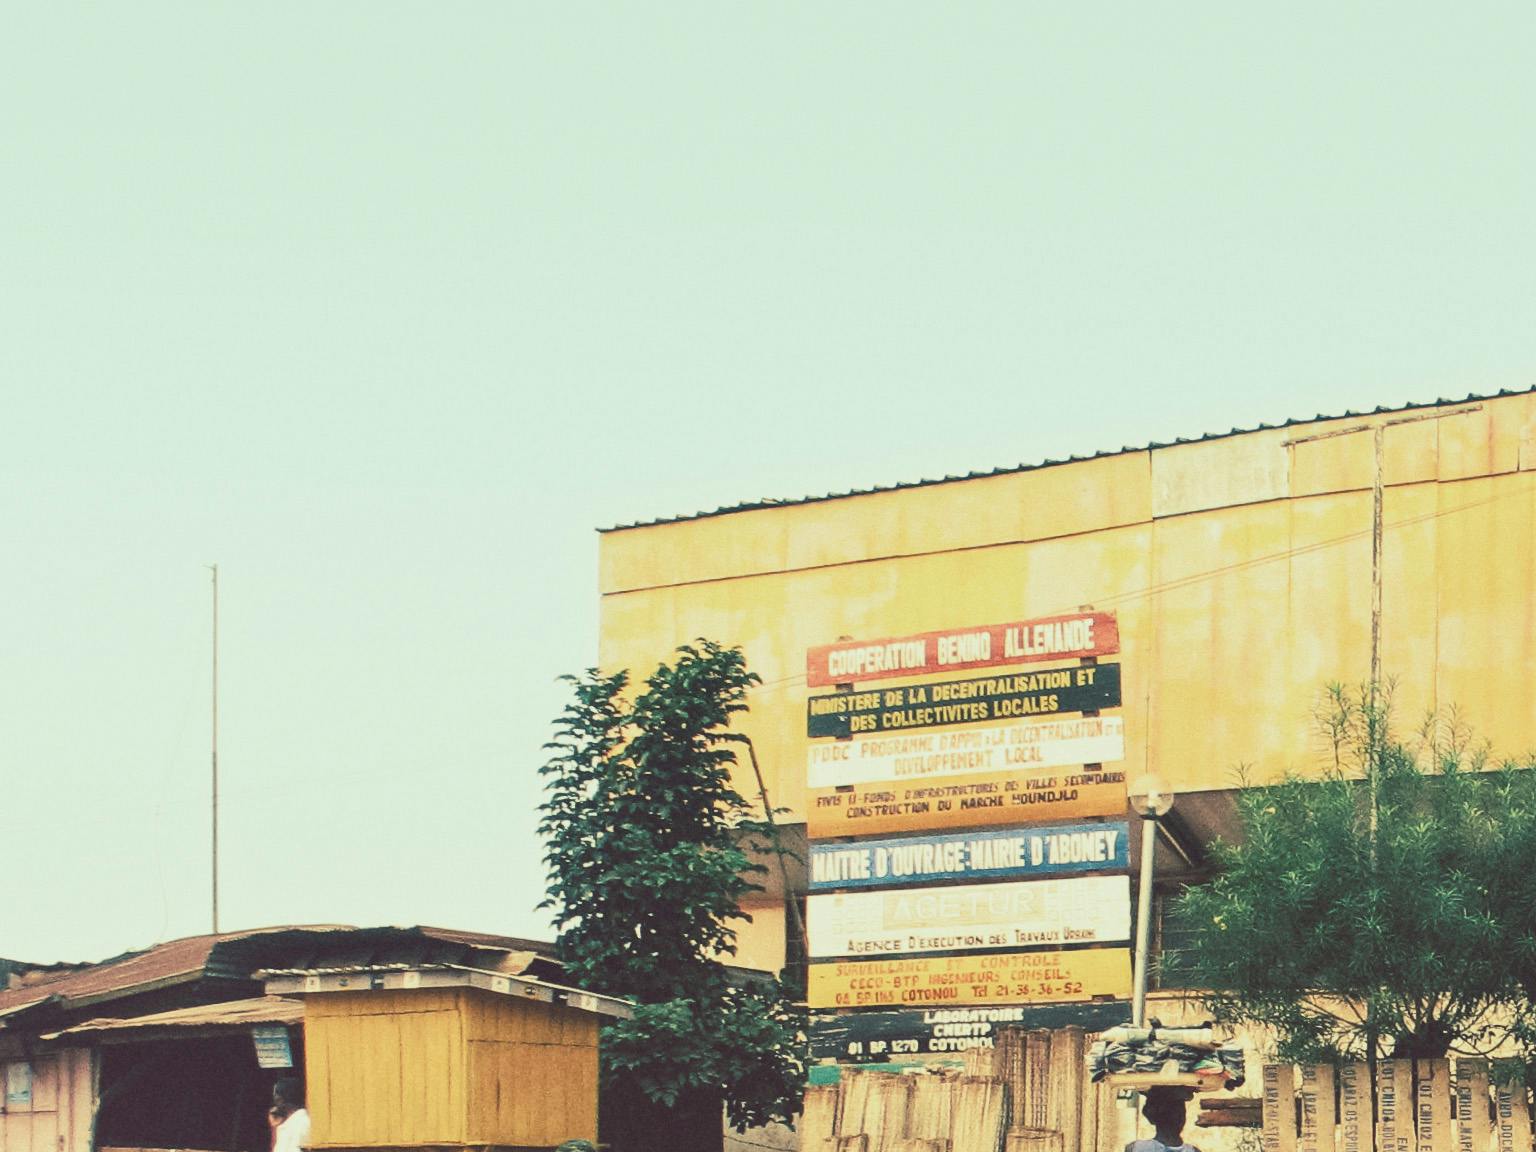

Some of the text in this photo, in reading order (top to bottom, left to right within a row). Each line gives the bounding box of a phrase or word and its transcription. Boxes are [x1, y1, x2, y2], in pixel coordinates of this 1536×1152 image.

[828, 640, 926, 677] COOPERATION
[1004, 618, 1096, 658] ALLEMANDE
[811, 669, 1096, 715] MINISTERE DE LA DECENTRALISATION ET
[851, 695, 1059, 731] DES COLLECTIVITES LOCALES
[847, 801, 929, 819] CONSTRUCTION
[938, 799, 952, 812] DU
[812, 849, 871, 882] MAITRE
[971, 837, 1025, 870] MAIRIE
[1031, 830, 1119, 866] D'ABOMEY
[836, 960, 930, 977] SURVEILLANCE
[981, 953, 1061, 969] CONTROLE
[901, 985, 958, 1002] COTONOU
